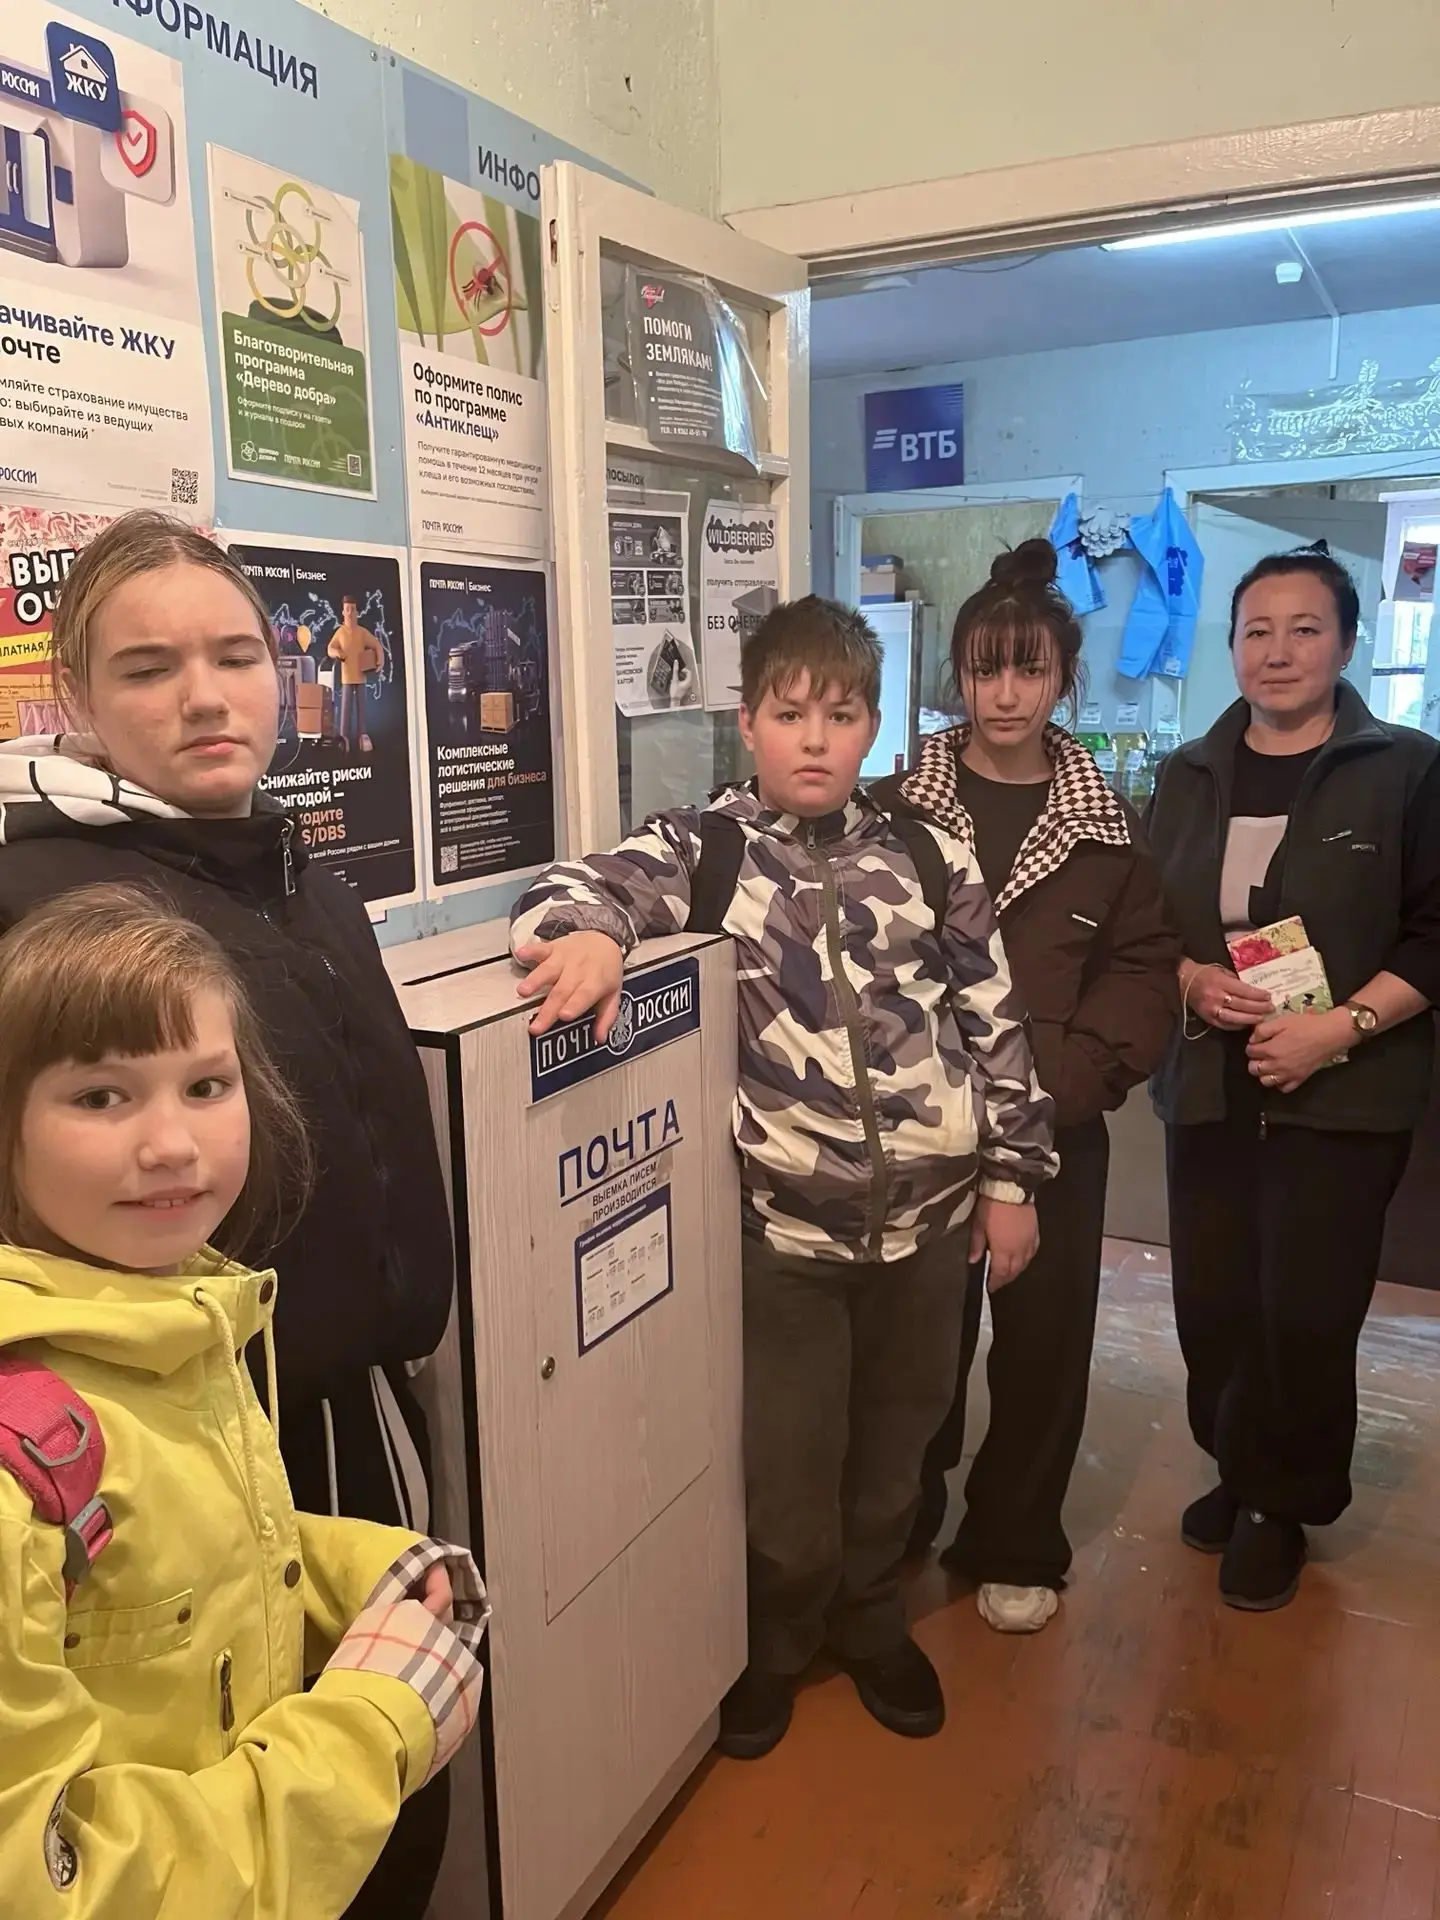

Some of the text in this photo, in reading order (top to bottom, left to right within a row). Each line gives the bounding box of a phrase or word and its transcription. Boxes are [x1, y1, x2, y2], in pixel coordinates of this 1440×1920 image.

[113, 0, 318, 99] ФОРМАЦИЯ
[1, 70, 40, 98] РОССИИ
[65, 72, 108, 101] ЖКУ
[120, 327, 175, 360] ЖКУ
[643, 316, 693, 342] ПОМОГИ
[233, 329, 355, 377] Благотворительная
[235, 352, 306, 381] программа
[646, 343, 713, 372] ЗЕМЛЯКАМ!
[236, 371, 337, 406] «Дерево добра»
[413, 362, 523, 407] Оформите полис
[15, 400, 84, 420] выбирайте
[87, 412, 101, 424] из
[104, 416, 154, 432] ведущих
[48, 385, 125, 409] страхование
[127, 401, 189, 421] имущества
[415, 388, 507, 422] по программе
[416, 409, 500, 443] «Антиклещ»
[417, 441, 450, 456] Получите
[900, 429, 957, 462] ВТБ
[0, 467, 37, 484] РОССИИ
[418, 456, 446, 468] помощь
[446, 461, 451, 469] в
[452, 462, 478, 474] течение
[419, 470, 441, 481] клеща
[448, 475, 459, 483] его
[708, 528, 773, 547] WILDBERRIES
[265, 567, 290, 579] РОССИИ
[296, 568, 327, 581] Бизнес
[469, 581, 492, 592] Бизнес
[707, 615, 725, 630] БЕЗ
[0, 641, 44, 657] ЛАТНАЯ
[437, 743, 509, 761] Комплексные
[257, 766, 372, 791] Снижайте риски
[438, 759, 515, 778] логистические
[439, 771, 547, 798] решения для бизнеса
[541, 984, 689, 1068] ПОЧТ РОССИИ
[558, 1099, 681, 1198] ПОЧТА
[592, 1161, 657, 1206] ВЫЕМКА ПИСЕМ
[592, 1177, 657, 1225] ПРОИЗВОДИТСЯ
